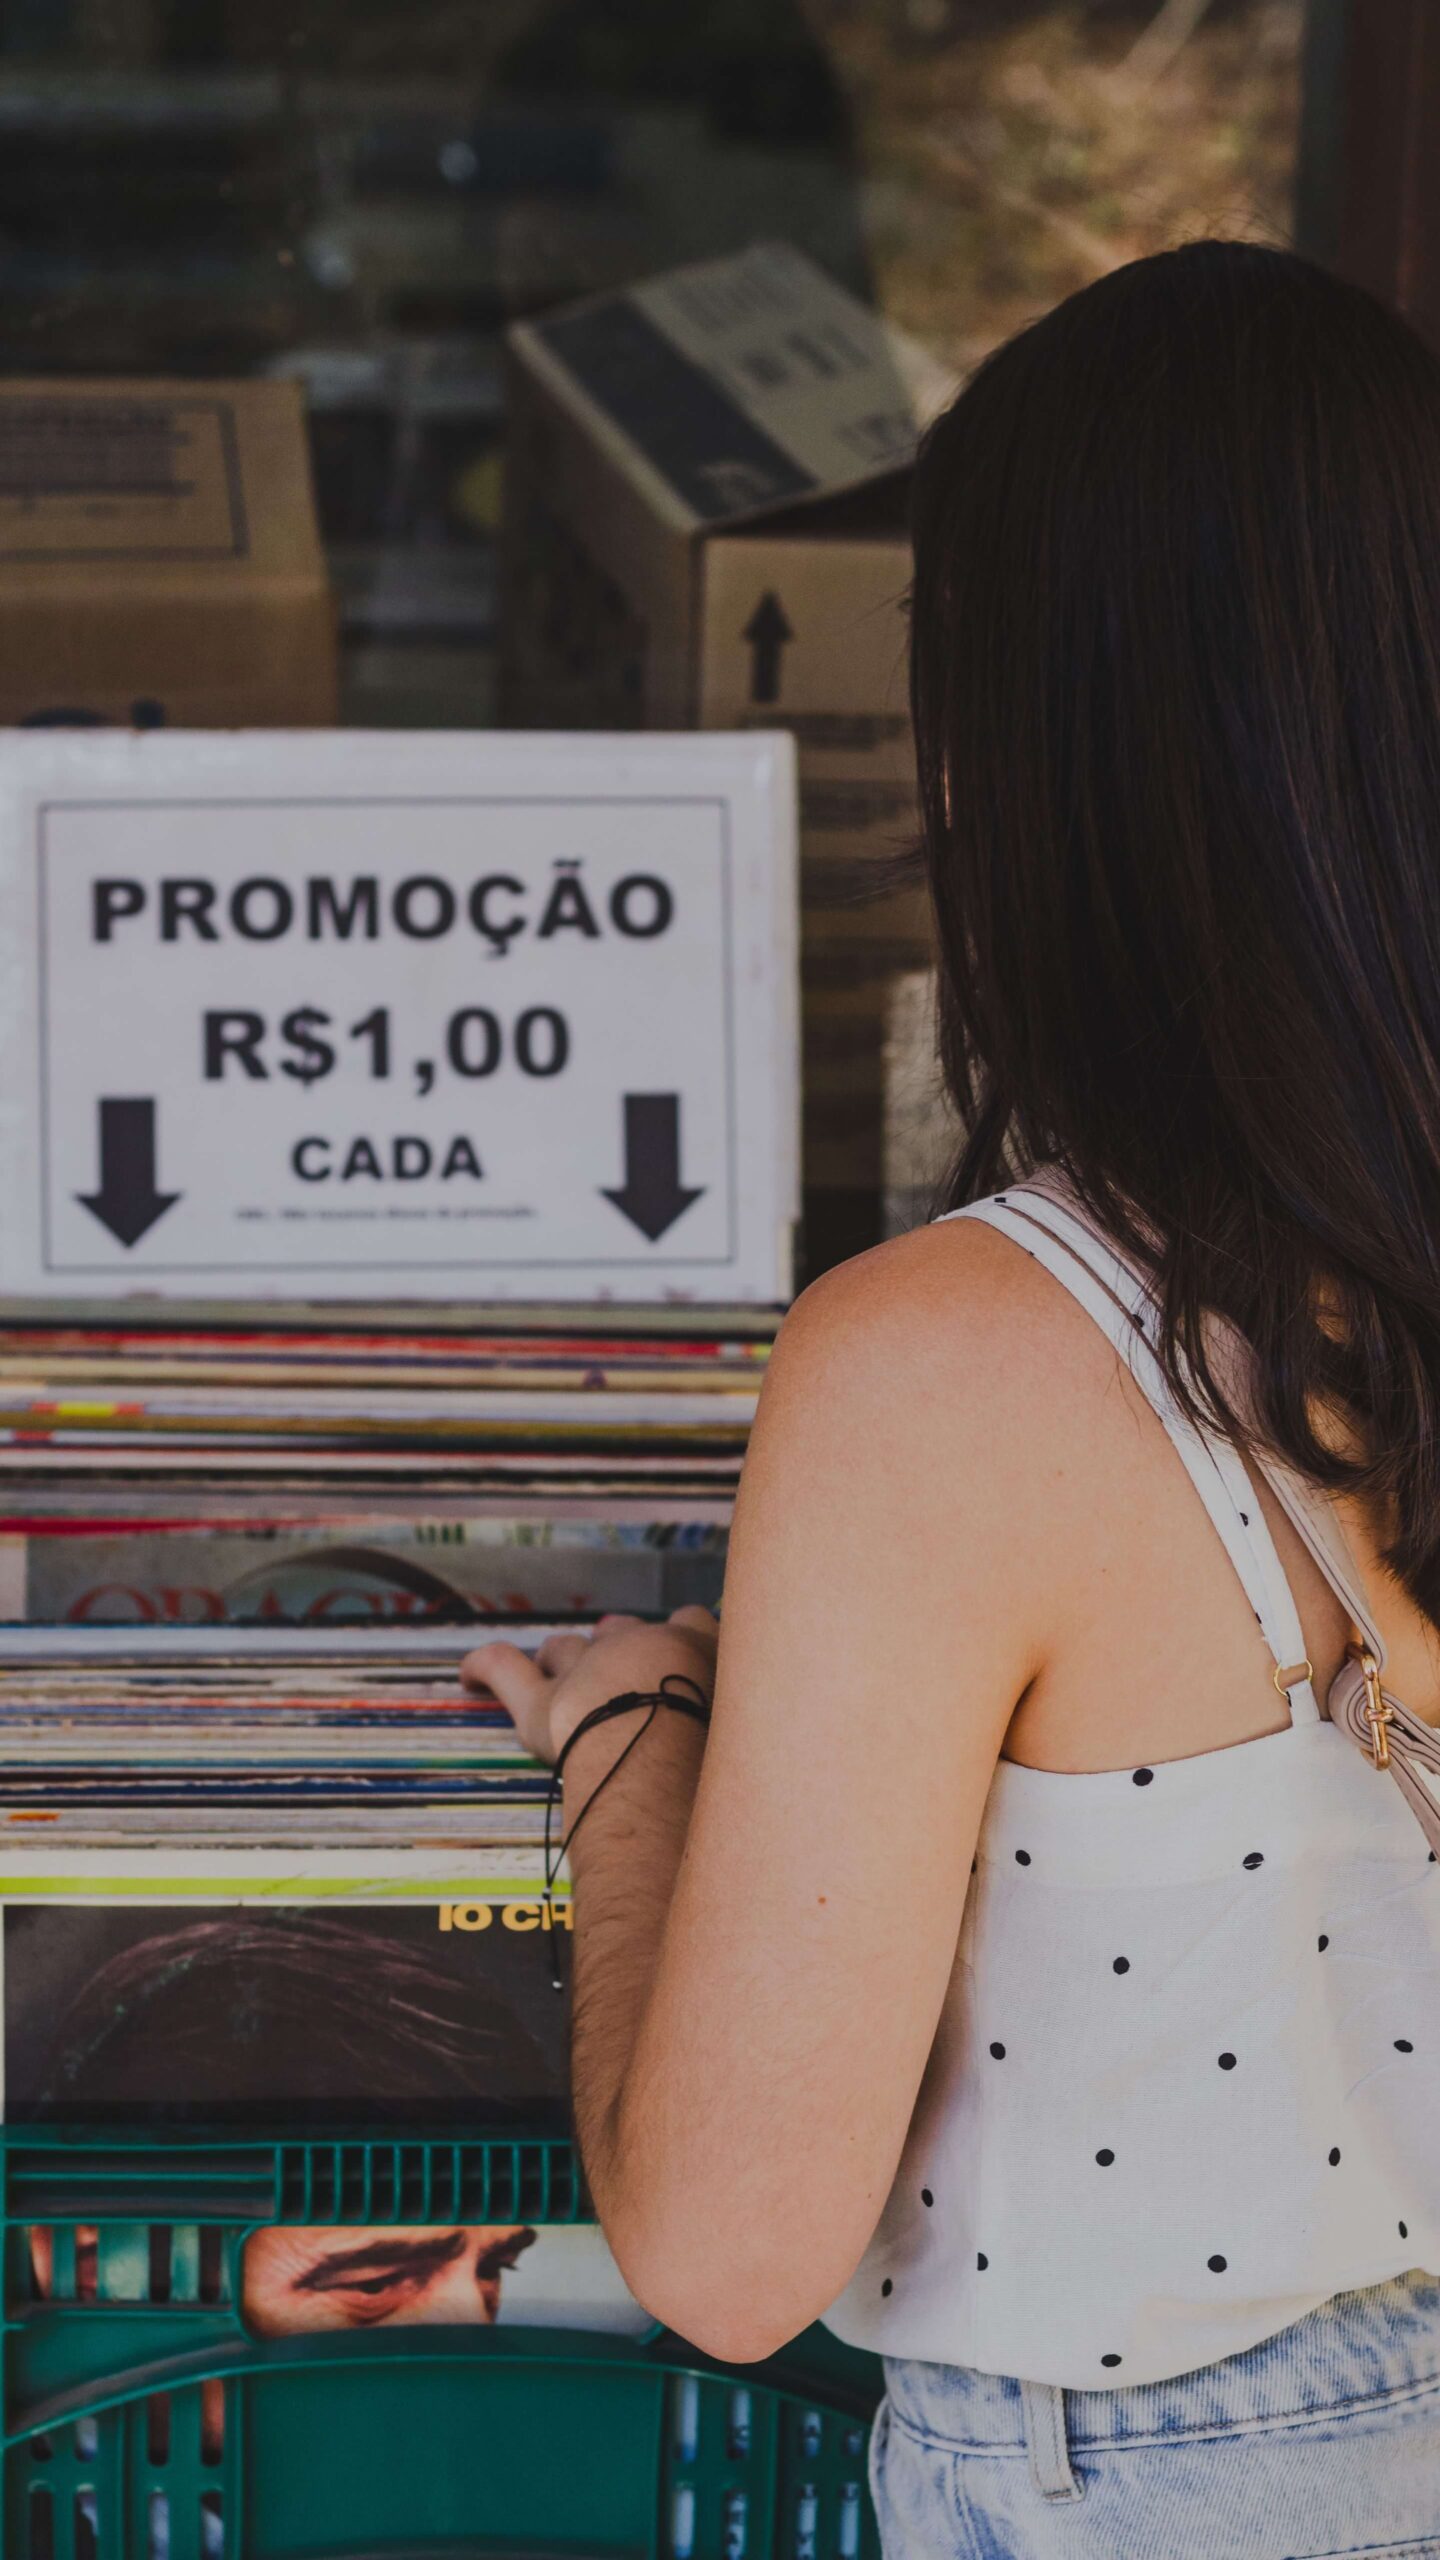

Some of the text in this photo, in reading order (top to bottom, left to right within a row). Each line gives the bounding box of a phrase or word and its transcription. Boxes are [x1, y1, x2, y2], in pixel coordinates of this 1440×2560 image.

[93, 858, 674, 959] PROMOÇÃO
[203, 1005, 570, 1096] R$1,00
[291, 1135, 484, 1182] CADA
